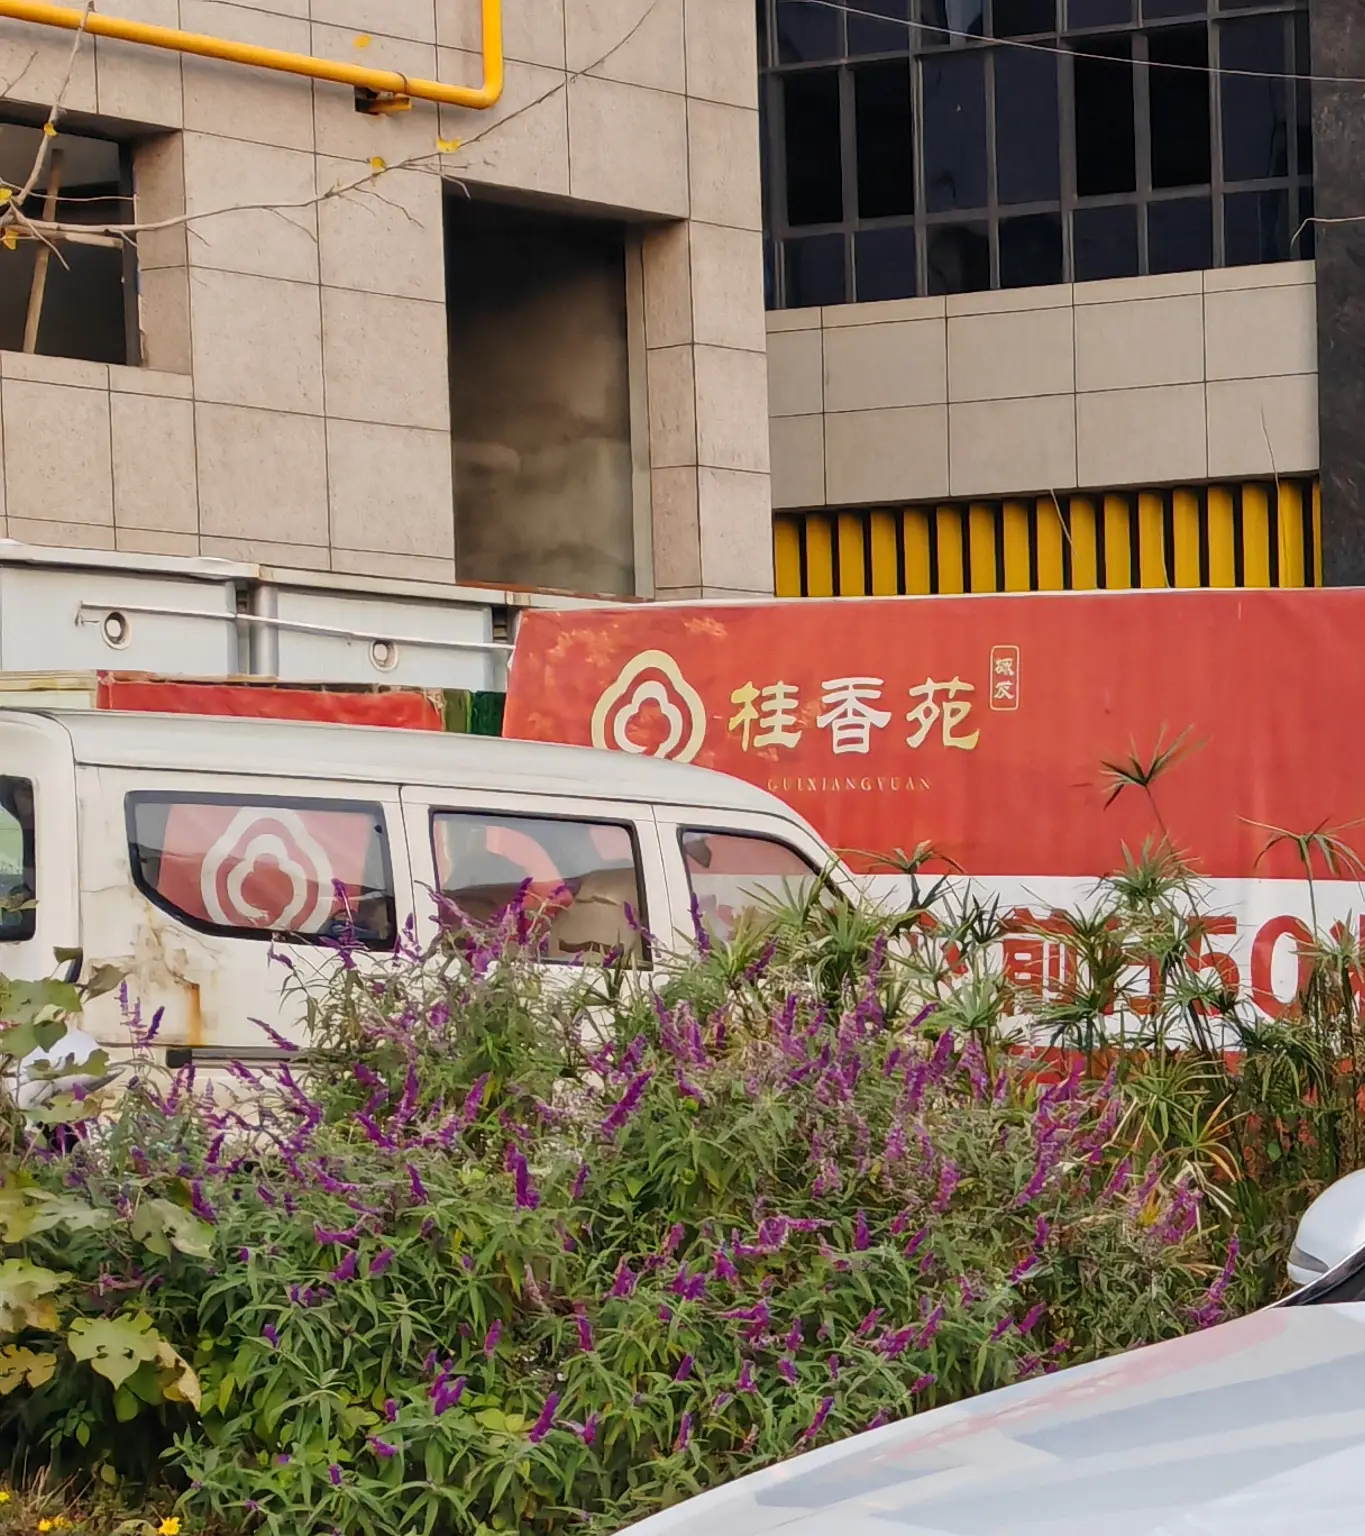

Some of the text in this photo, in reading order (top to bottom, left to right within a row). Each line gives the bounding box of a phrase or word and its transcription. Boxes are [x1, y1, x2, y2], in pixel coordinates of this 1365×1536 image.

[728, 675, 980, 755] 桂香苑
[766, 775, 933, 792] GUIXIANGYUAN
